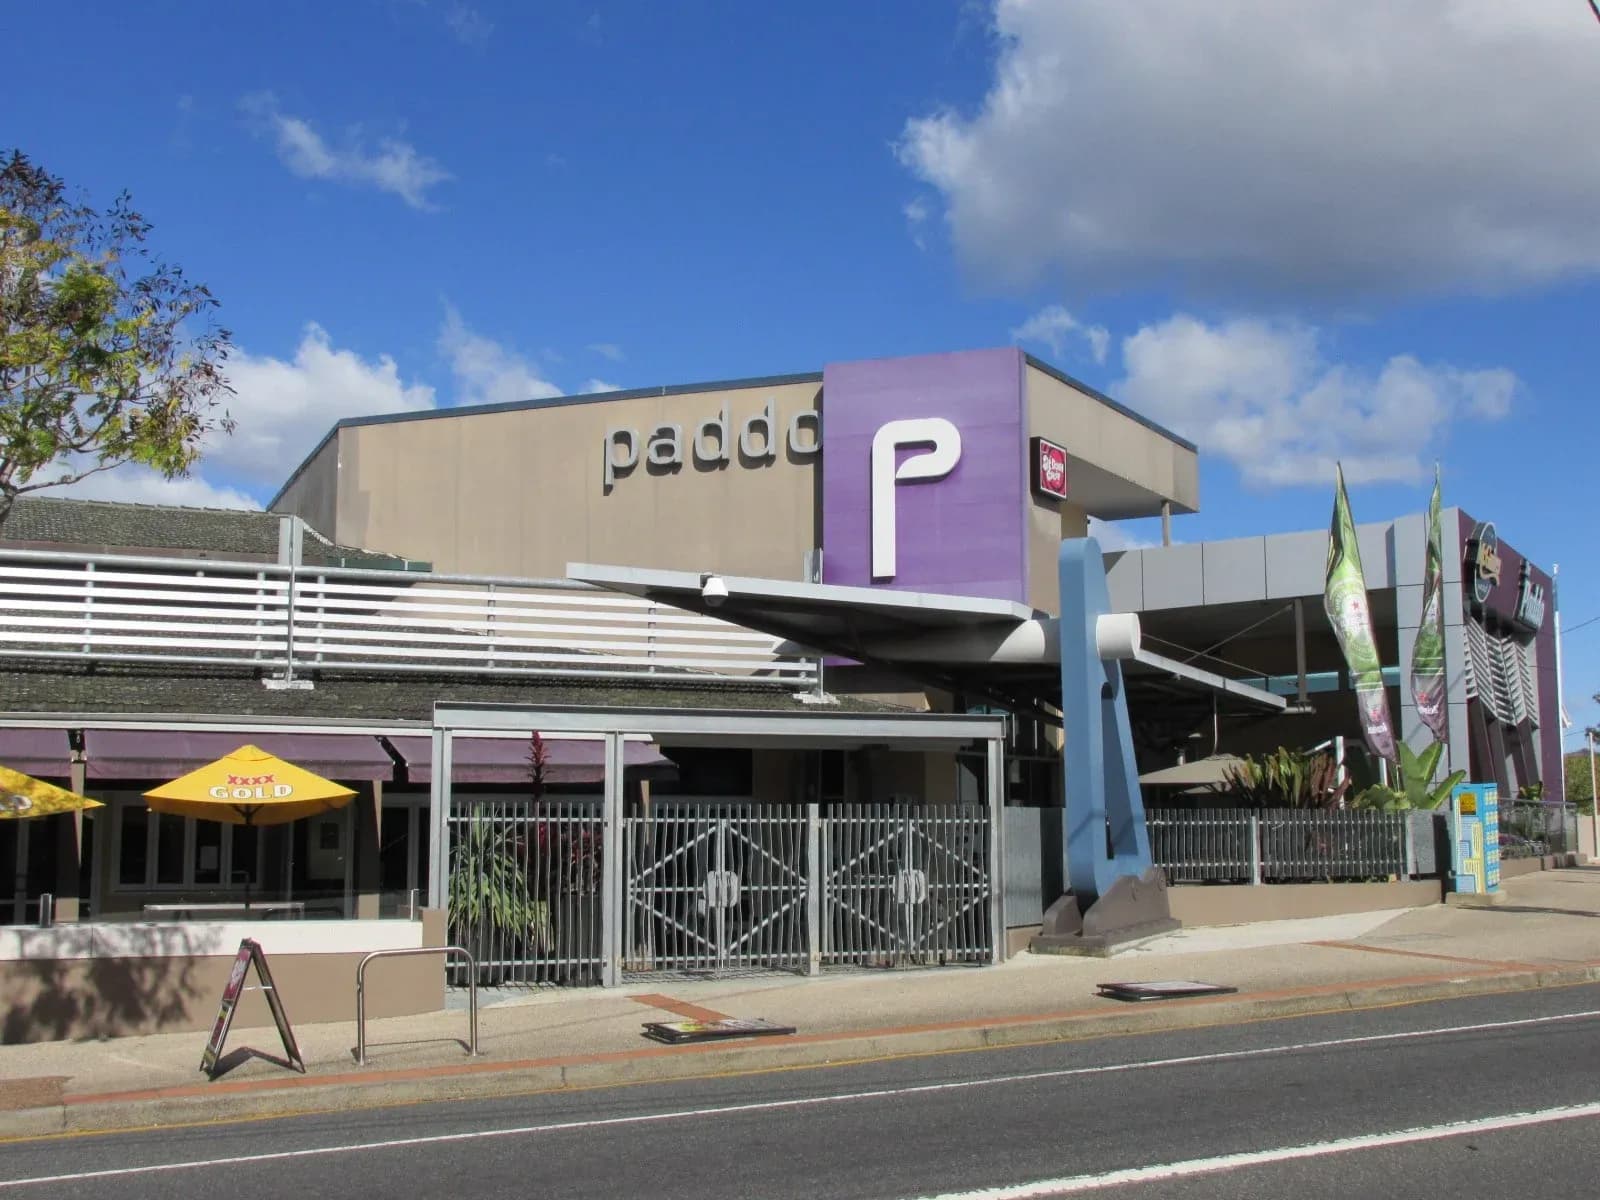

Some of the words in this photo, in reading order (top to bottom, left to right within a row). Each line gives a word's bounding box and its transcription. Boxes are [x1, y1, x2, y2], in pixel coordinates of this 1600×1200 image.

[605, 395, 823, 485] paddo
[872, 417, 962, 578] P
[208, 784, 294, 800] GOLD
[227, 773, 275, 786] XXXX
